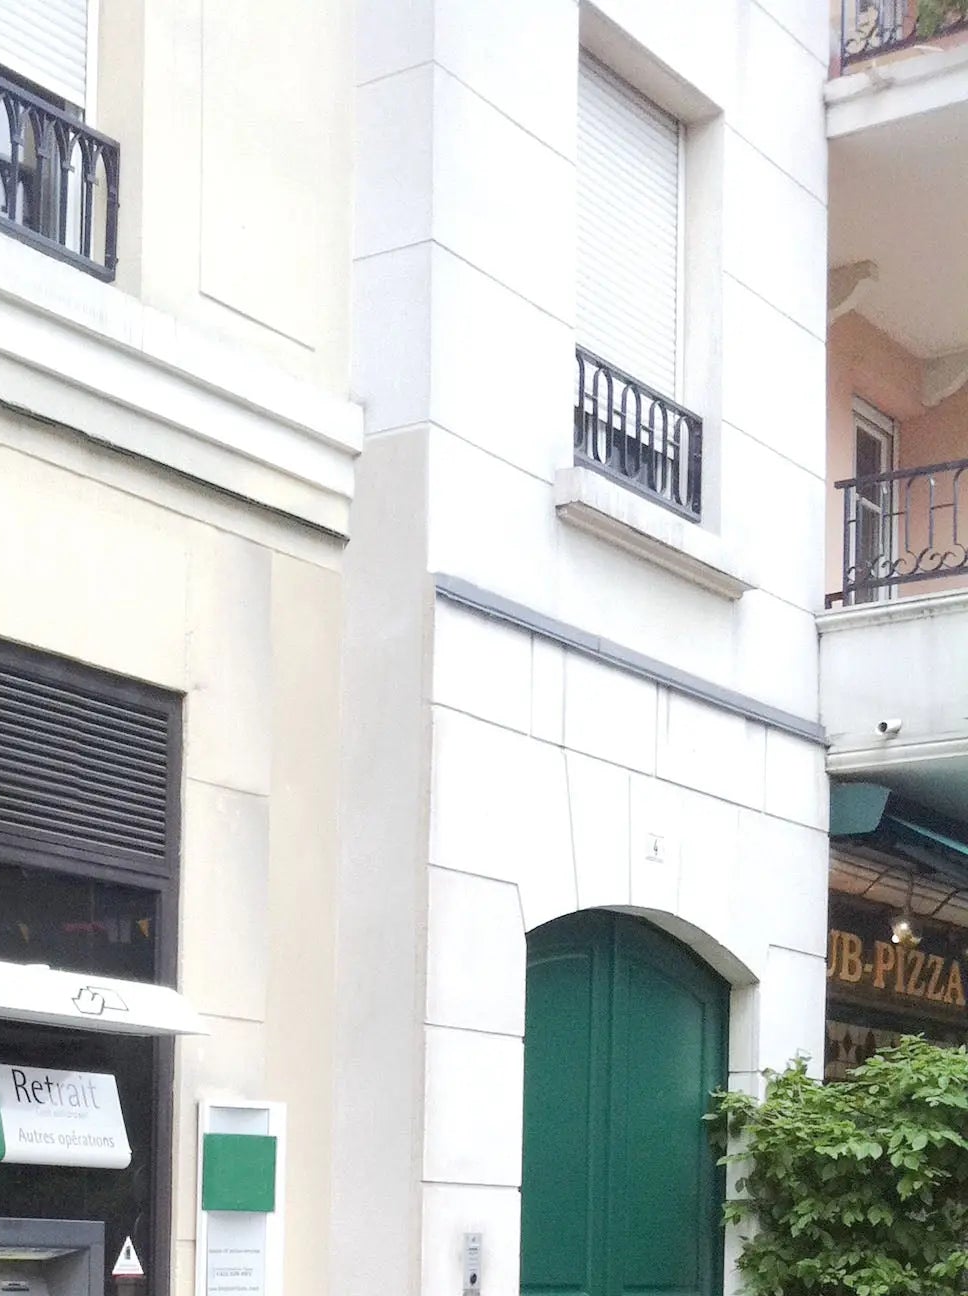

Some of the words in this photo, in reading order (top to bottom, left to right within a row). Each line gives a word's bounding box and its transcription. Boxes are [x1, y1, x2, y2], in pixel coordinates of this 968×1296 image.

[12, 1068, 100, 1109] Retrait
[18, 1127, 55, 1145] Autres
[58, 1130, 115, 1149] opérations
